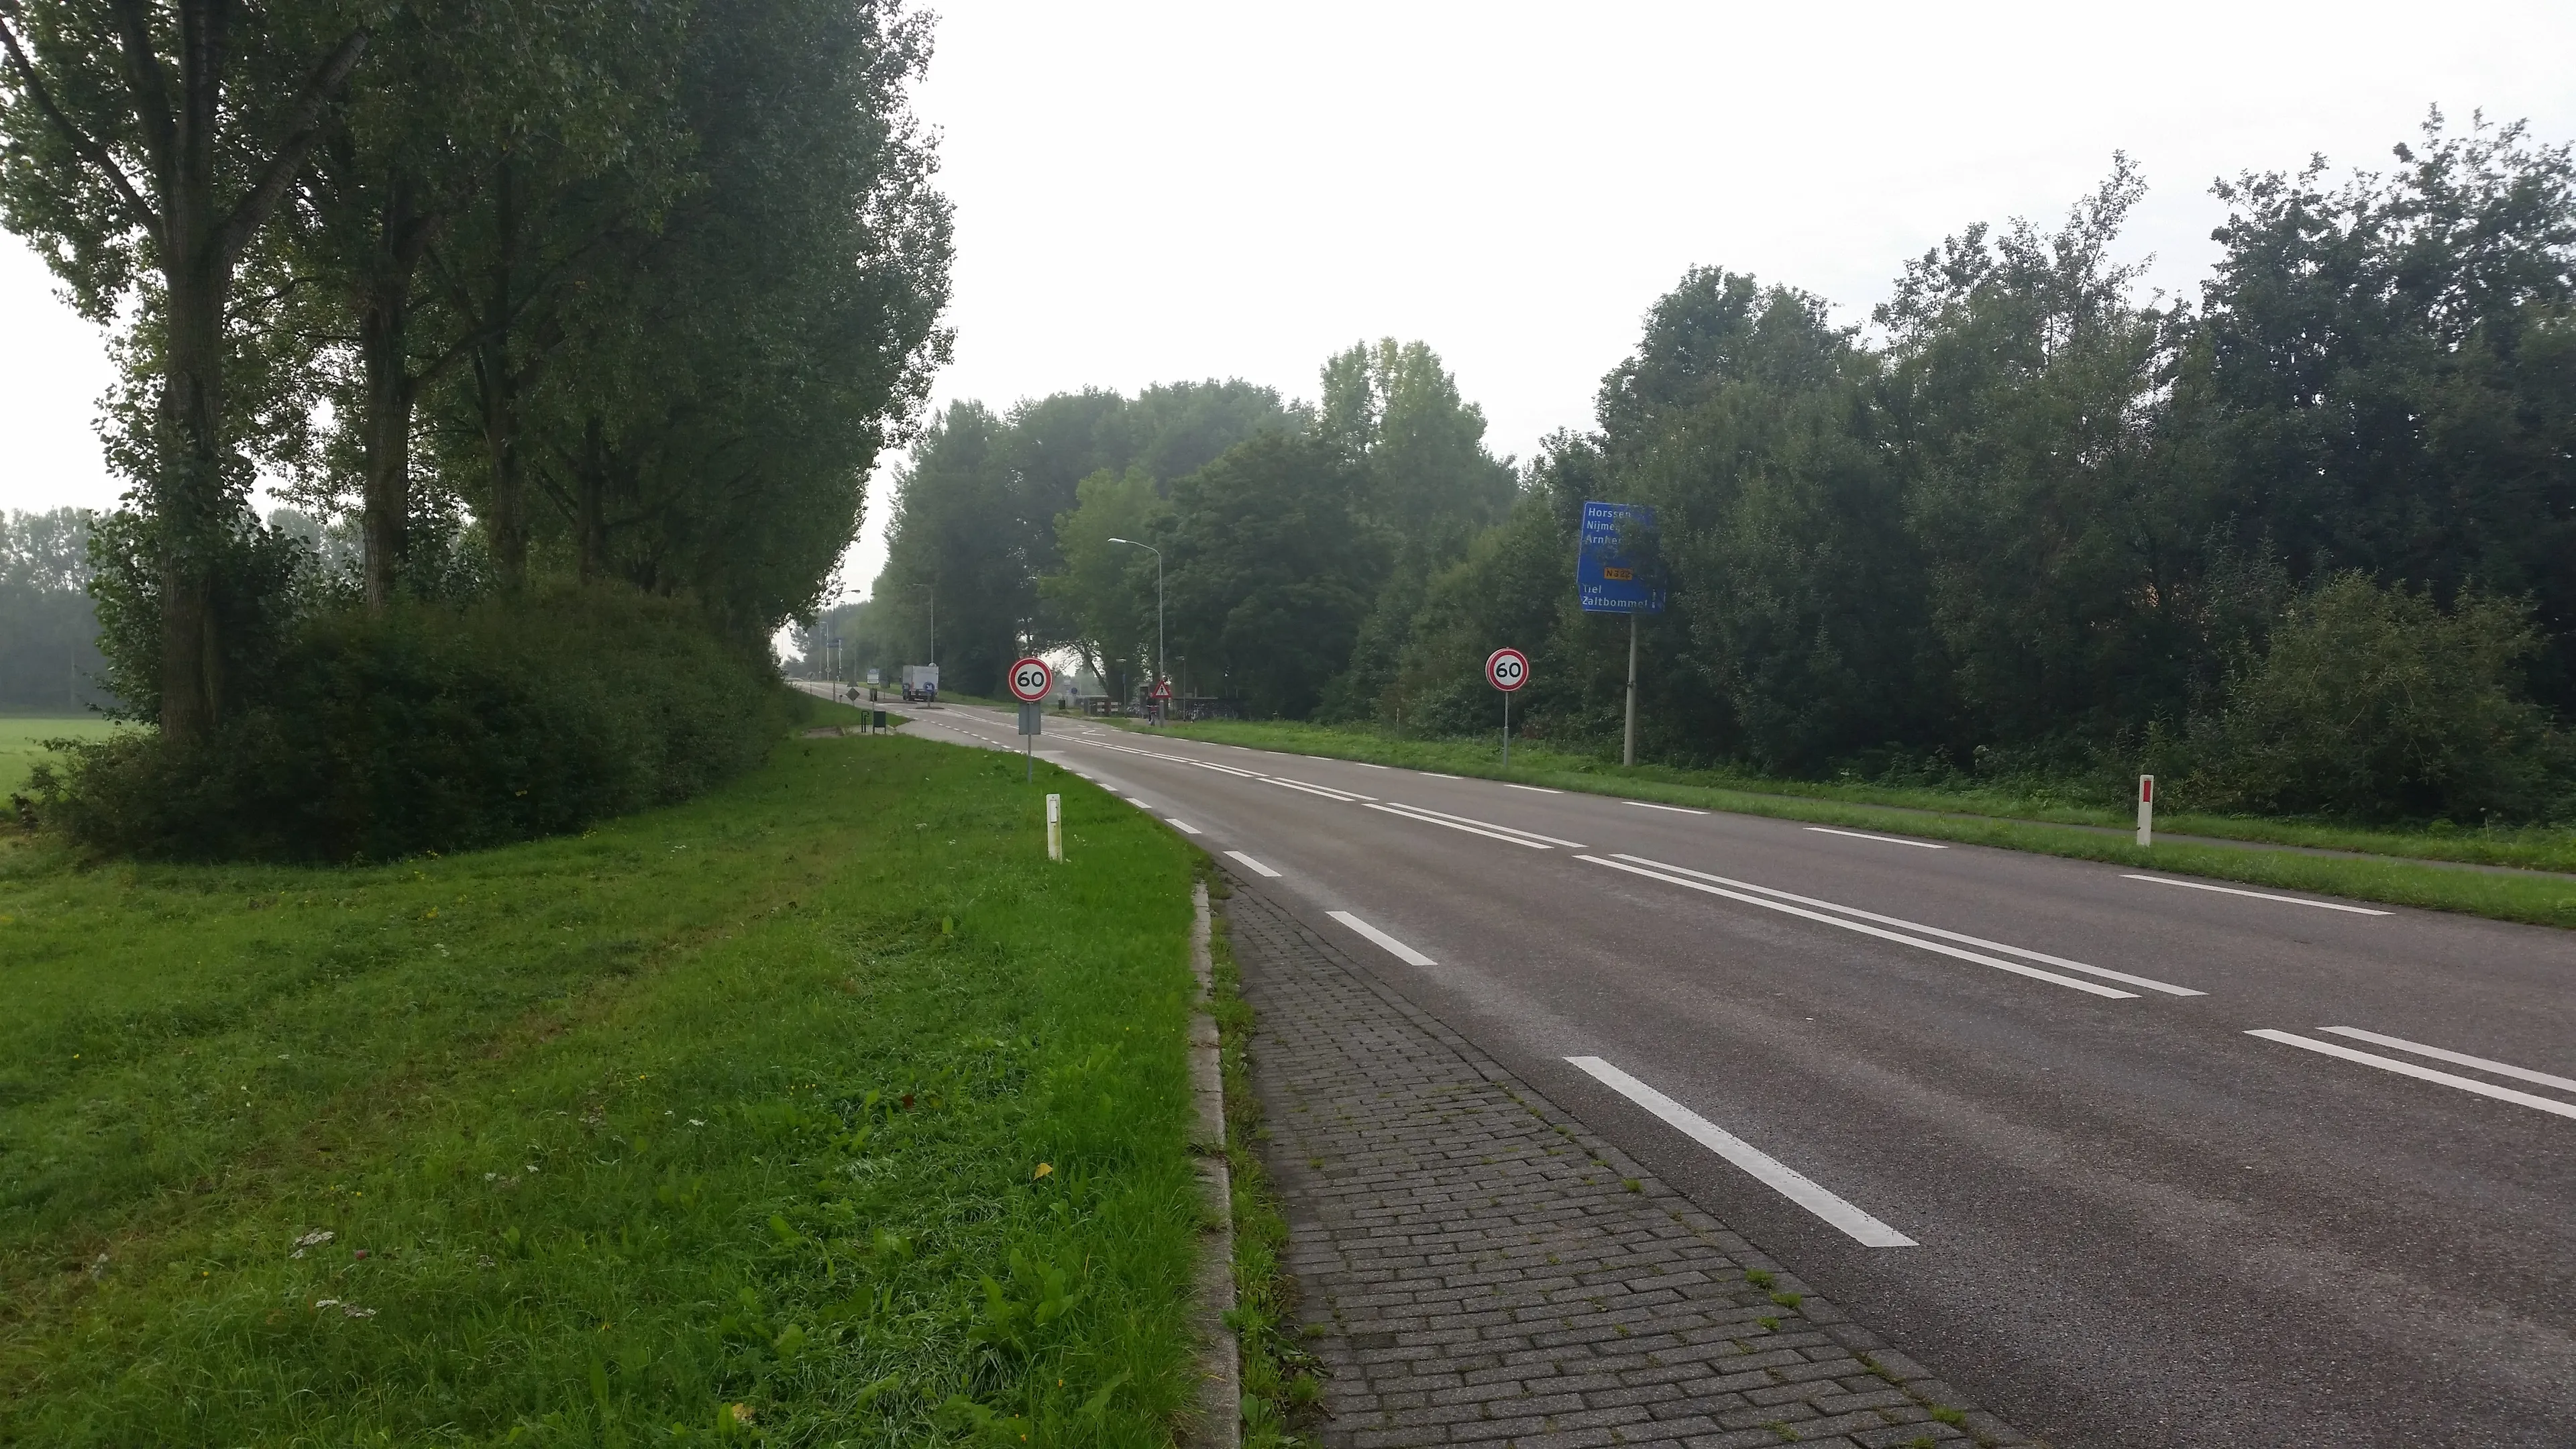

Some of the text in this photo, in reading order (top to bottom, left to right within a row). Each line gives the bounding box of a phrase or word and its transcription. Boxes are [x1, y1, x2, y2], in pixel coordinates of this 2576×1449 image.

[1588, 507, 1631, 518] Horssen
[1587, 521, 1620, 532] Nijme
[1606, 570, 1632, 578] N322
[1496, 662, 1521, 678] 60
[1017, 671, 1044, 688] 60
